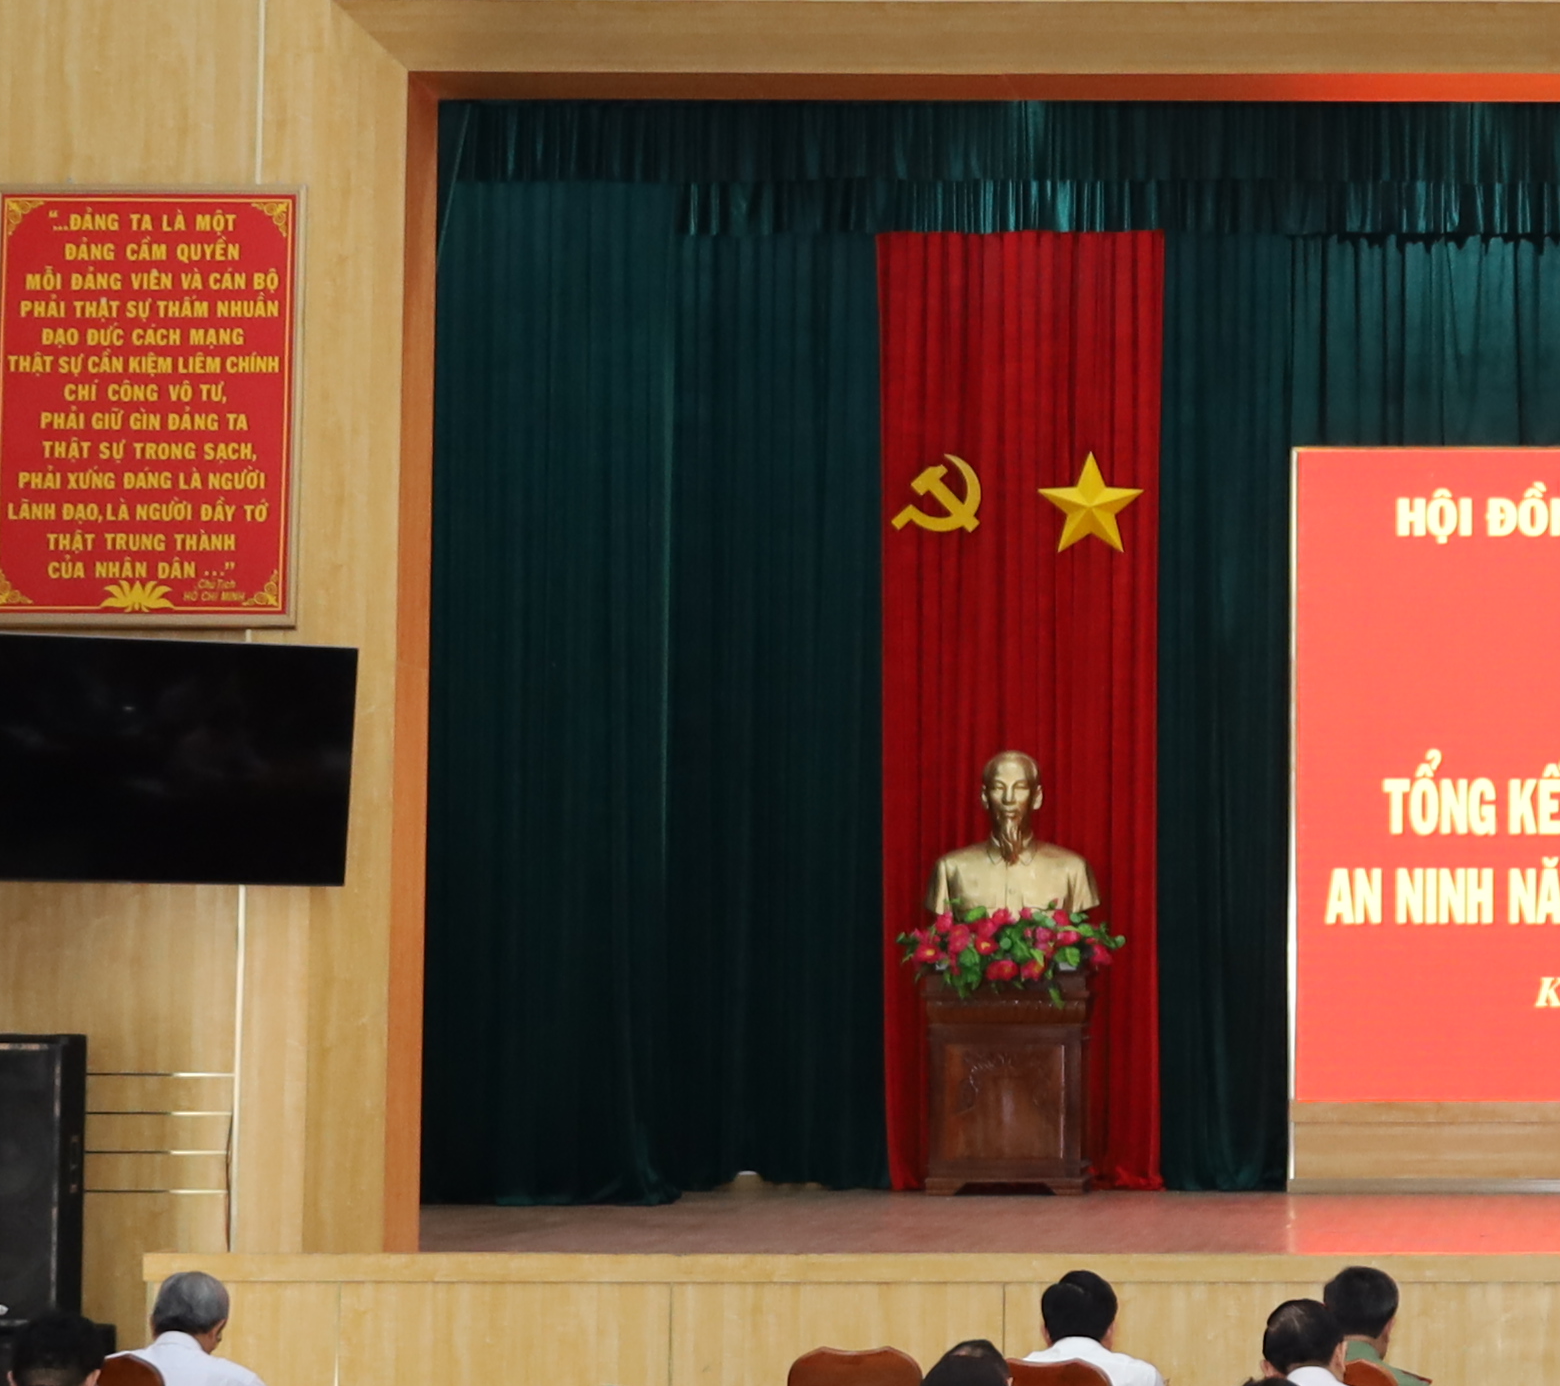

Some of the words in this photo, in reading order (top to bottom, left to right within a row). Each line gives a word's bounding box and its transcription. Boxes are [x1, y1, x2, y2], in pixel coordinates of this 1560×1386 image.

[130, 214, 152, 230] TA
[162, 209, 186, 231] LÀ
[196, 210, 236, 235] MỘT
[65, 237, 115, 260] ĐẢNG
[126, 236, 167, 260] CẦM
[177, 236, 239, 263] QUYỀN
[26, 266, 61, 290] MỖI
[71, 267, 121, 290] ĐẢNG
[131, 269, 172, 290] VIÊN
[181, 268, 202, 290] VÀ
[209, 268, 246, 290] CÁN
[253, 268, 278, 294] BỘ
[20, 294, 65, 317] PHẢI
[73, 297, 120, 322] THẬT
[126, 298, 152, 321] SỰ
[157, 296, 208, 318] THẤM
[217, 292, 279, 317] NHUẦN
[42, 328, 79, 348] ĐẠO
[87, 323, 124, 346] ĐỨC
[132, 324, 180, 345] CÁCH
[190, 328, 243, 349] MẠNG
[8, 352, 54, 376] THẬT
[59, 354, 84, 376] SỰ
[88, 349, 123, 373] CẦN
[129, 352, 172, 376] KIỆM
[178, 352, 221, 373] LIÊM
[226, 352, 279, 373] CHÍNH
[64, 380, 98, 401] CHÍ
[108, 380, 158, 401] CÔNG
[169, 380, 192, 402] VÔ
[200, 381, 226, 403] TƯ,
[41, 406, 84, 429] PHẢI
[92, 408, 124, 430] GIỮ
[130, 408, 160, 430] GÌN
[168, 406, 218, 431] ĐẢNG
[226, 414, 248, 430] TA
[43, 437, 91, 461] THẬT
[100, 440, 126, 463] SỰ
[133, 442, 196, 460] TRONG
[204, 443, 256, 463] SẠCH,
[19, 466, 60, 489] PHẢI
[68, 466, 115, 489] XỨNG
[123, 468, 171, 489] ĐÁNG
[179, 468, 202, 489] LÀ
[208, 466, 265, 490] NGƯỜI
[1396, 488, 1472, 544] HỘI
[47, 530, 95, 556] THẬT
[105, 533, 165, 551] TRUNG
[174, 530, 235, 551] THÀNH
[48, 555, 84, 578] CỦA
[96, 557, 146, 578] NHÂN
[158, 557, 195, 579] DÂN
[1382, 749, 1496, 836] TỔNG
[1325, 868, 1382, 924] AN
[1395, 868, 1493, 924] NINH
